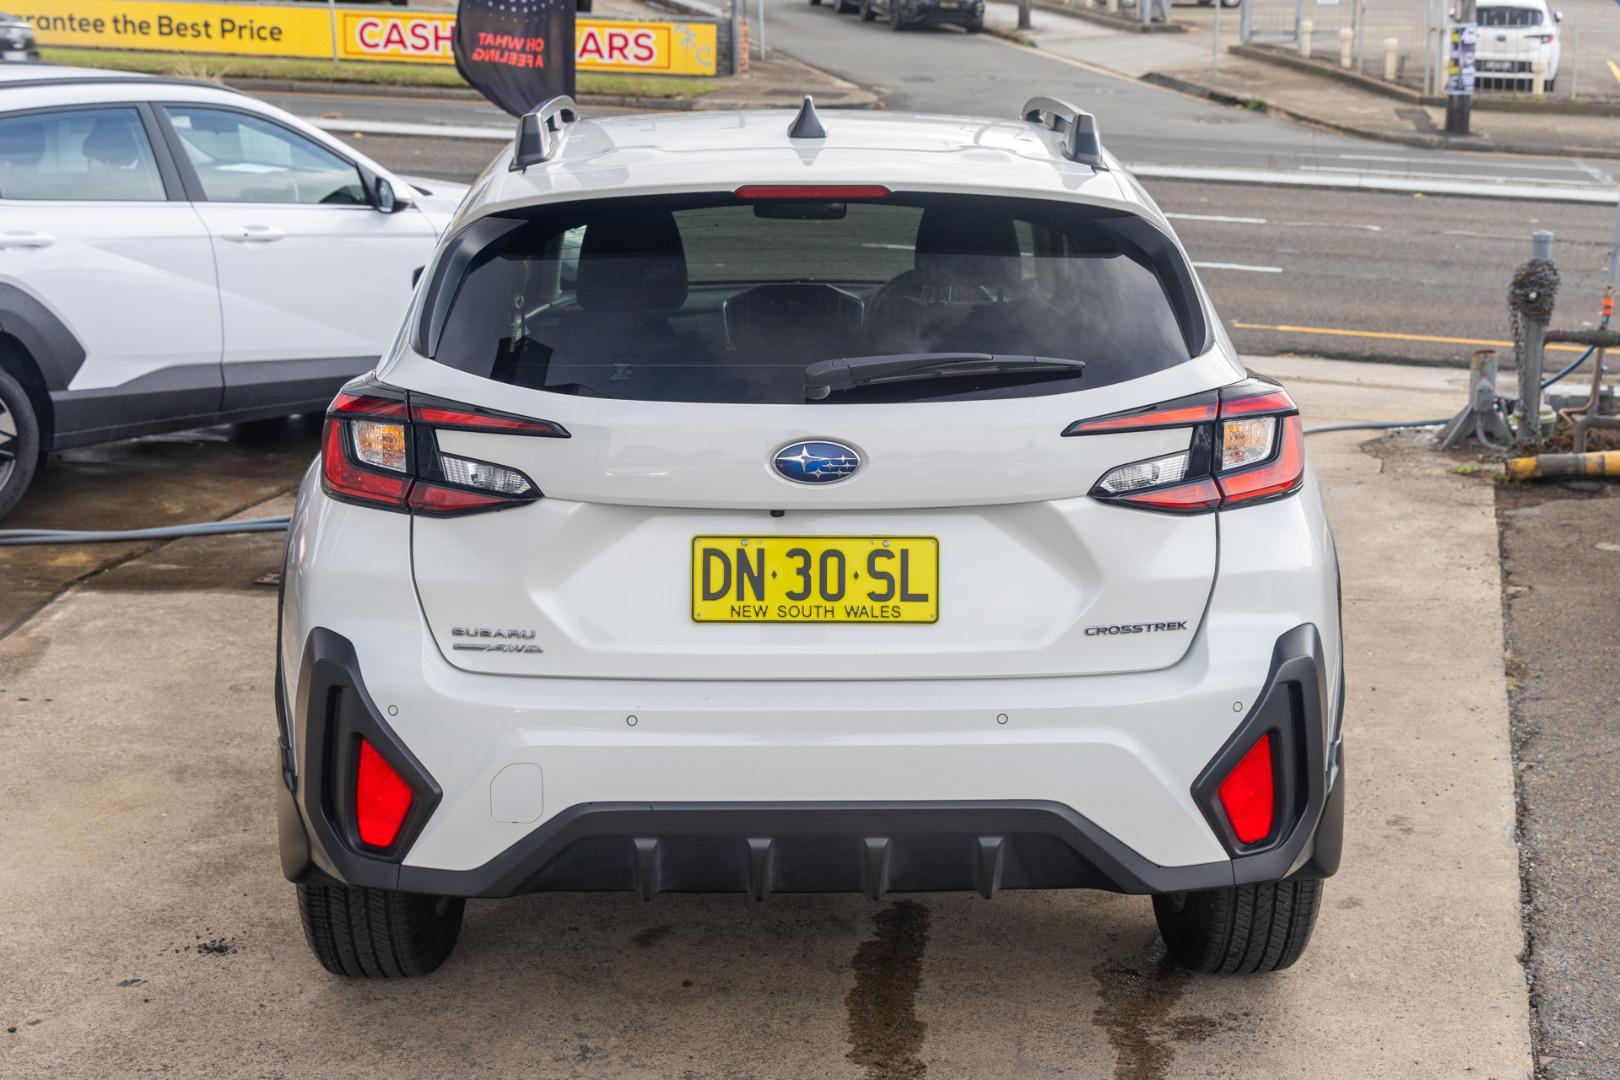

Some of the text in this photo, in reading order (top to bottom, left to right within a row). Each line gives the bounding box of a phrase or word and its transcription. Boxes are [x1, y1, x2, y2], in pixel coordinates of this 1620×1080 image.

[25, 13, 283, 41] rantee the Best Price
[359, 21, 654, 61] CASH ARS
[730, 605, 902, 618] NEW SOUTH WALES
[451, 626, 537, 640] SUBARU
[1084, 619, 1188, 636] CROSSTREK
